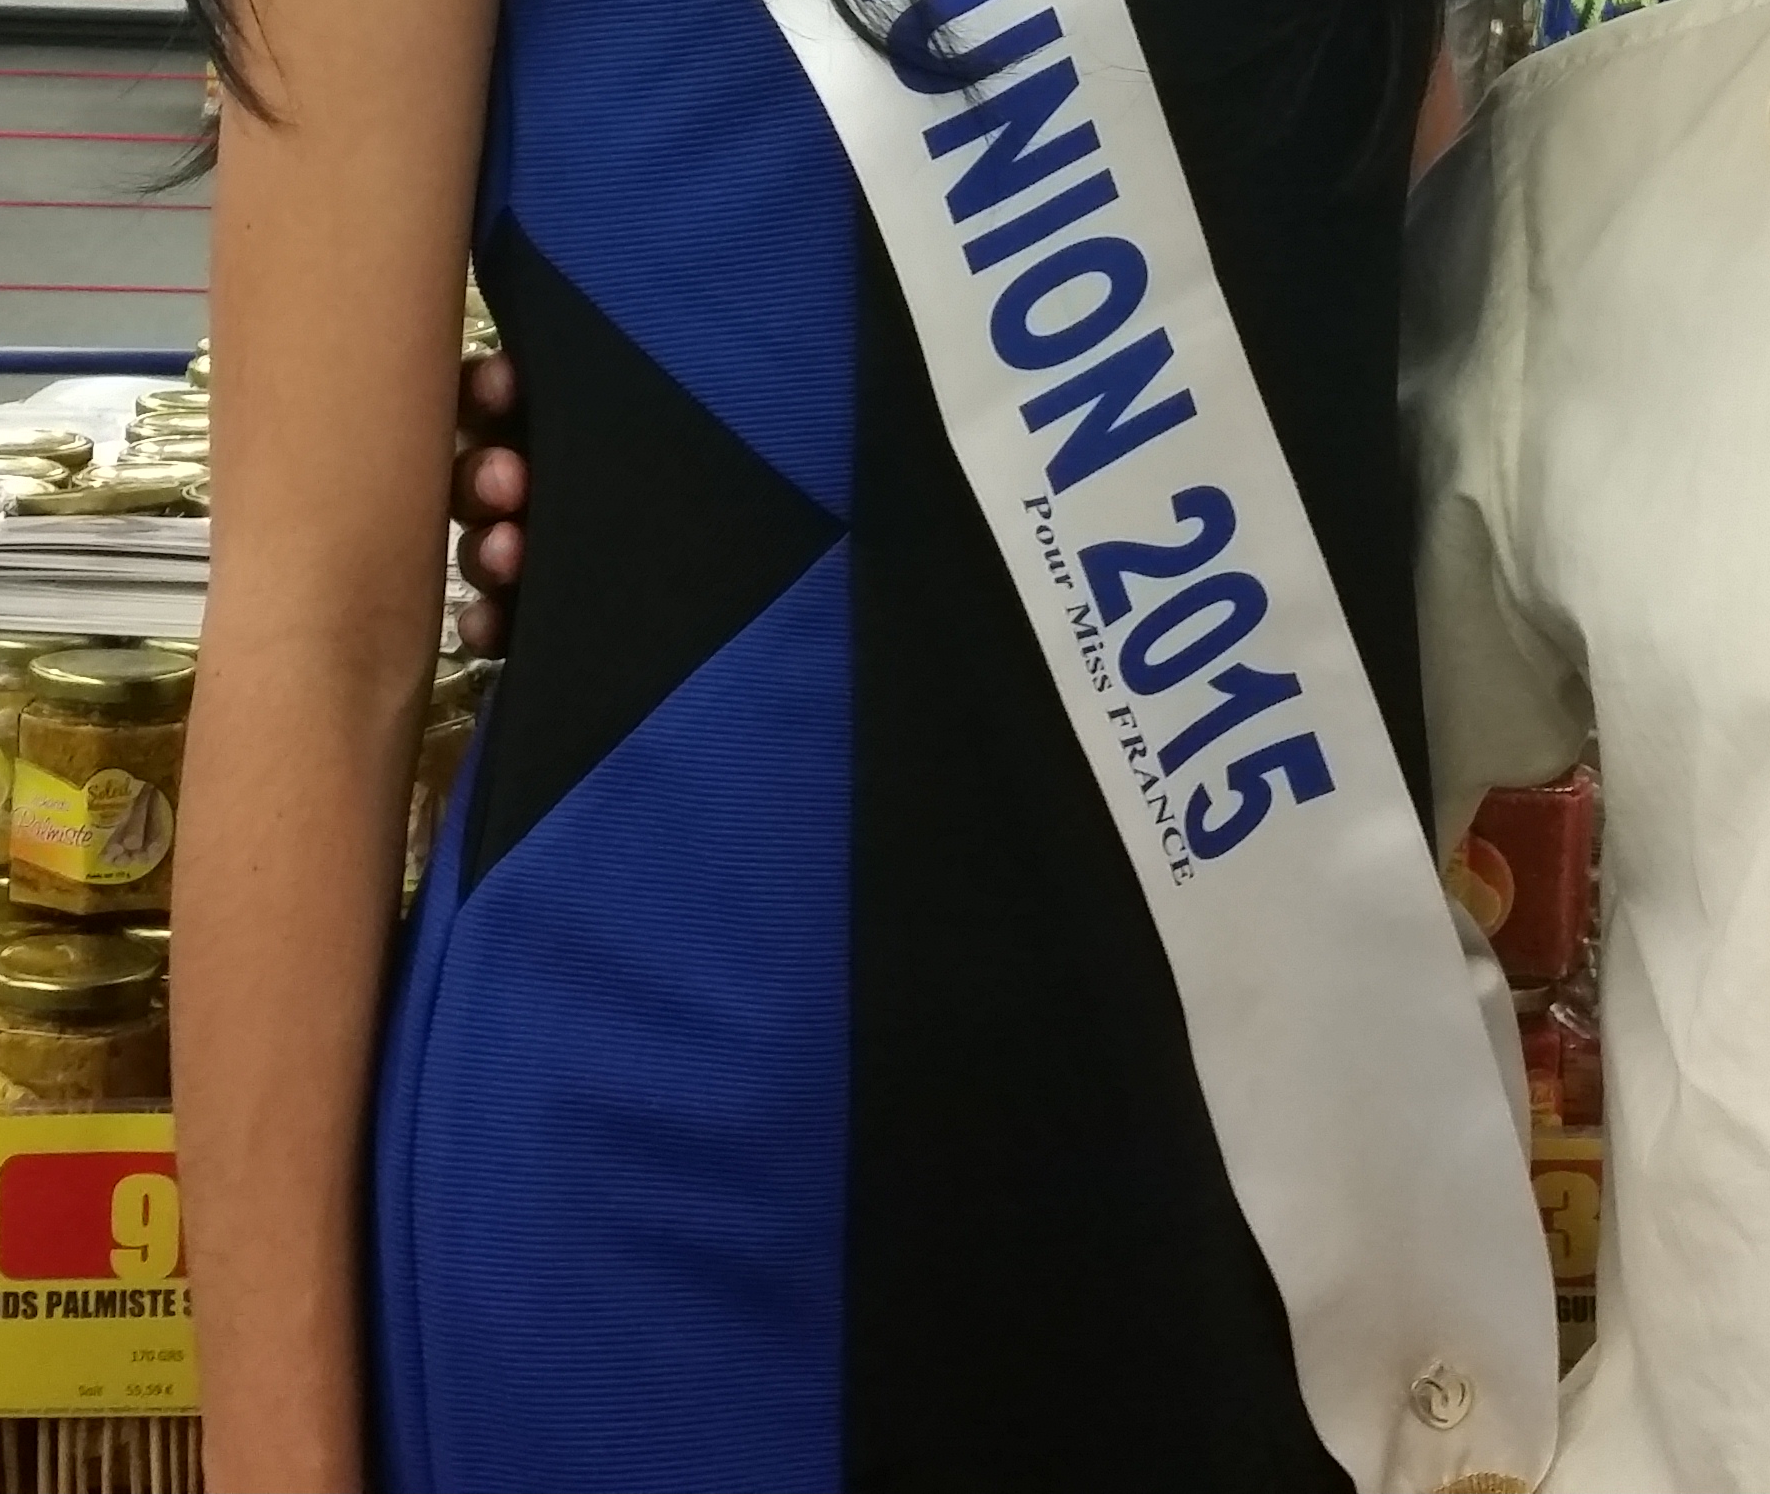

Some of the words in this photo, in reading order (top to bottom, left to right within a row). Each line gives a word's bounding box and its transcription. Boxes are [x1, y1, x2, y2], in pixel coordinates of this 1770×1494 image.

[1022, 493, 1074, 592] Pour
[1065, 603, 1114, 695] Miss
[1107, 704, 1196, 888] FRANCE
[1080, 484, 1337, 862] 2015
[45, 1288, 177, 1319] PALMISTE
[110, 1172, 180, 1280] 9
